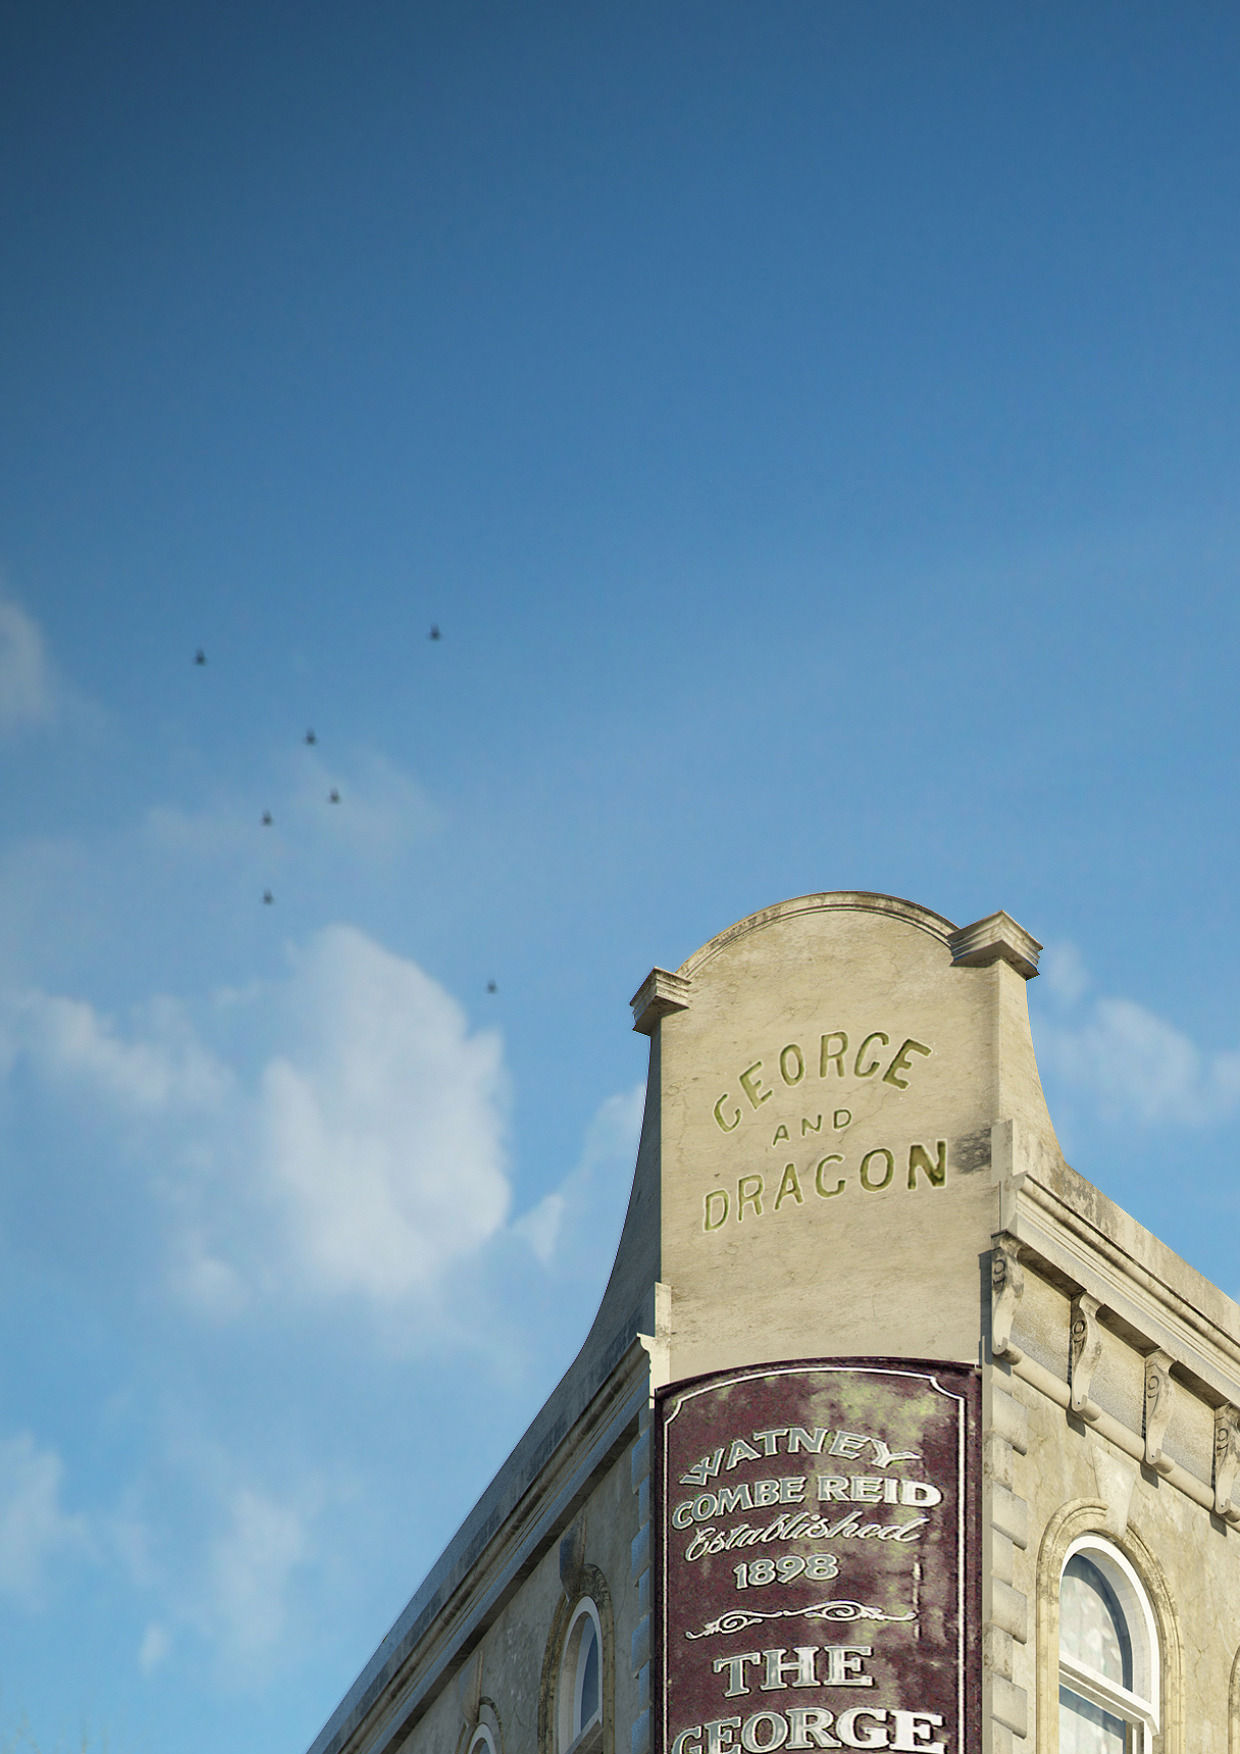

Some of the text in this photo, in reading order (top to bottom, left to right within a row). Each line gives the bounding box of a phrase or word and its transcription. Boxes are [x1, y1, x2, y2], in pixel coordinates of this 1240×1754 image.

[713, 1031, 932, 1134] GEORGE
[772, 1108, 852, 1146] AND
[703, 1139, 947, 1232] DRAGON
[680, 1428, 921, 1485] WATNEY
[672, 1476, 942, 1529] COMBE REID
[685, 1511, 929, 1561] Established
[733, 1554, 839, 1589] 1898
[713, 1646, 873, 1697] THE
